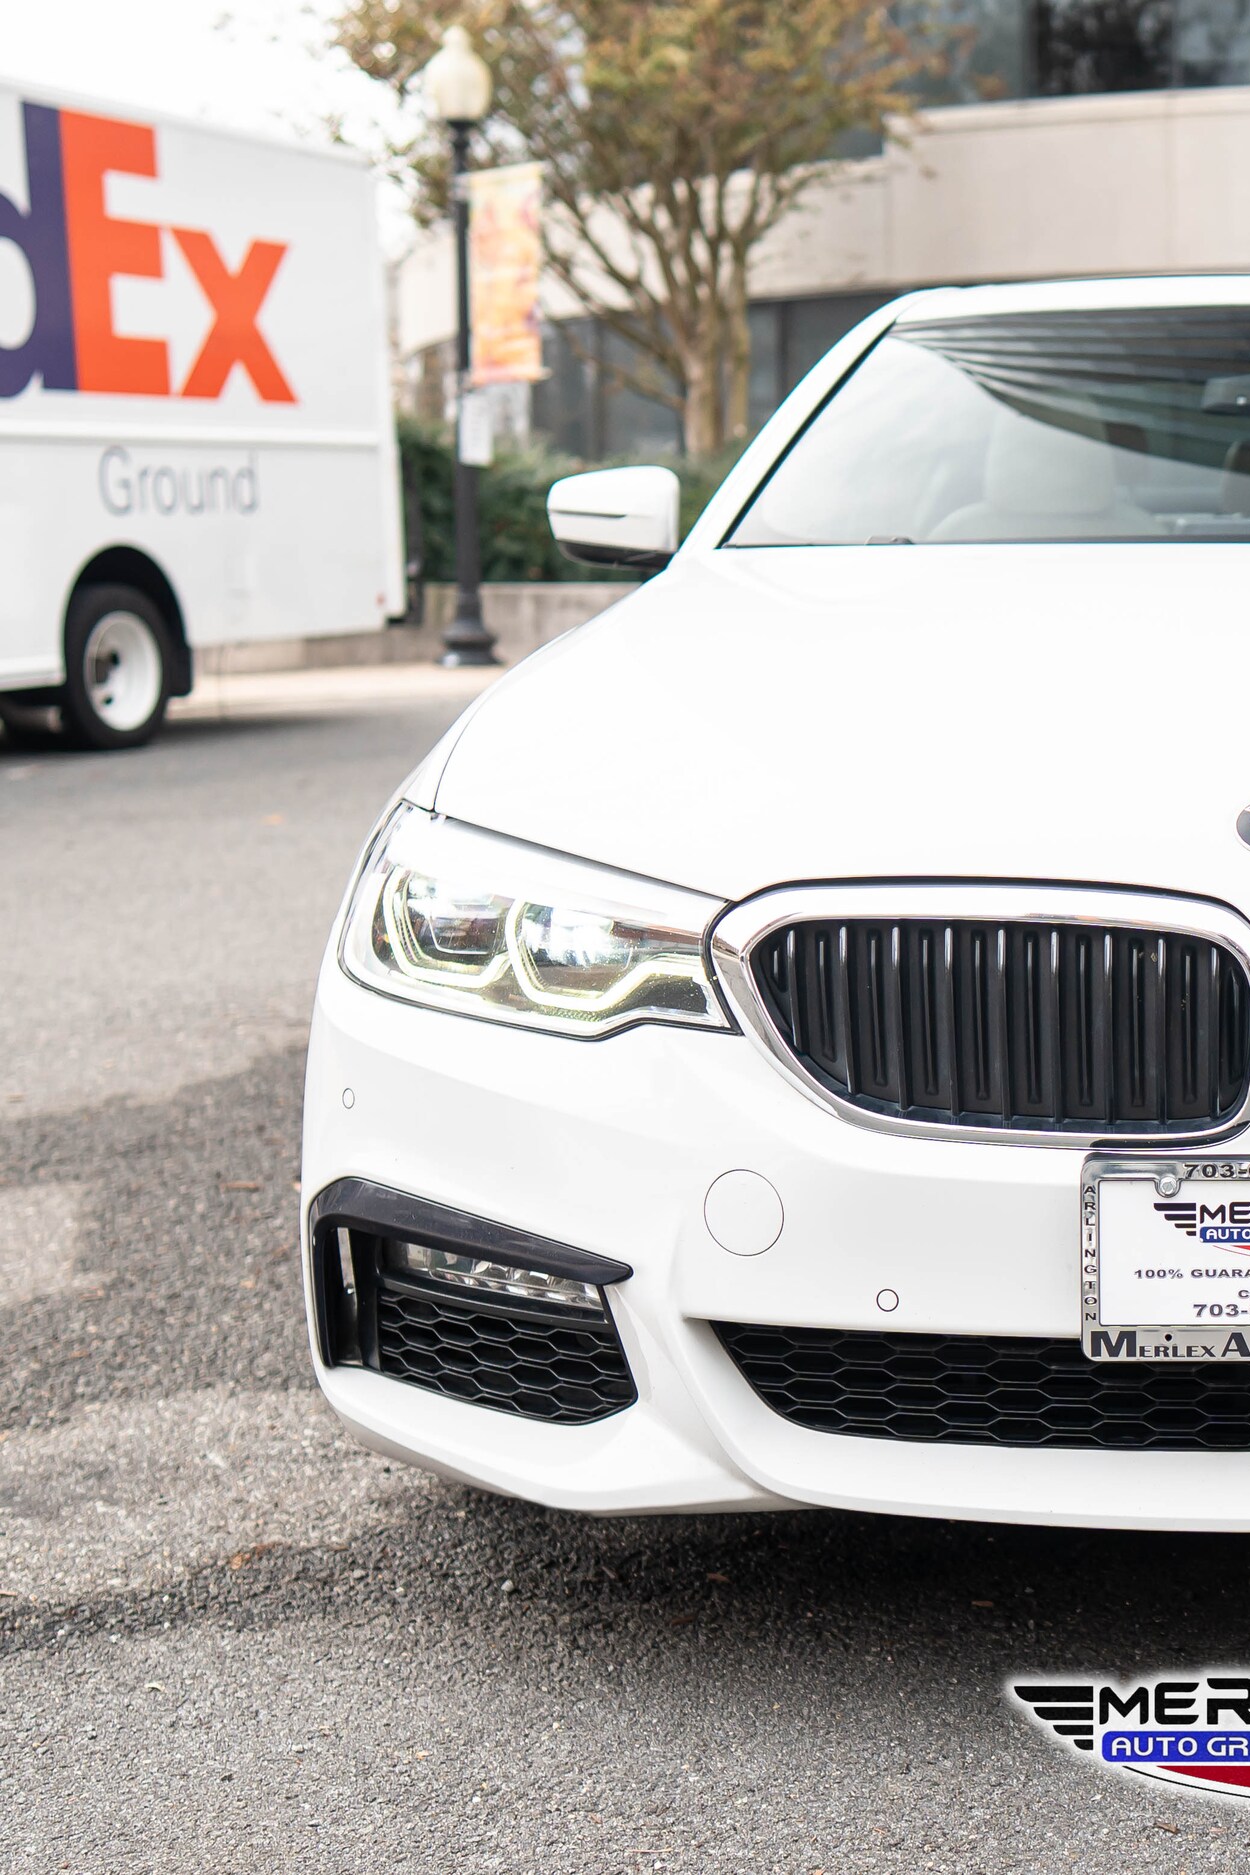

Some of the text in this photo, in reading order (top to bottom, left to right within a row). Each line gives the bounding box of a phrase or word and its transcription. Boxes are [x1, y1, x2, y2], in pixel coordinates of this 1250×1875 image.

[98, 443, 260, 516] Ground
[1083, 1184, 1098, 1322] ARLINGTON
[1133, 1268, 1184, 1279] 100%
